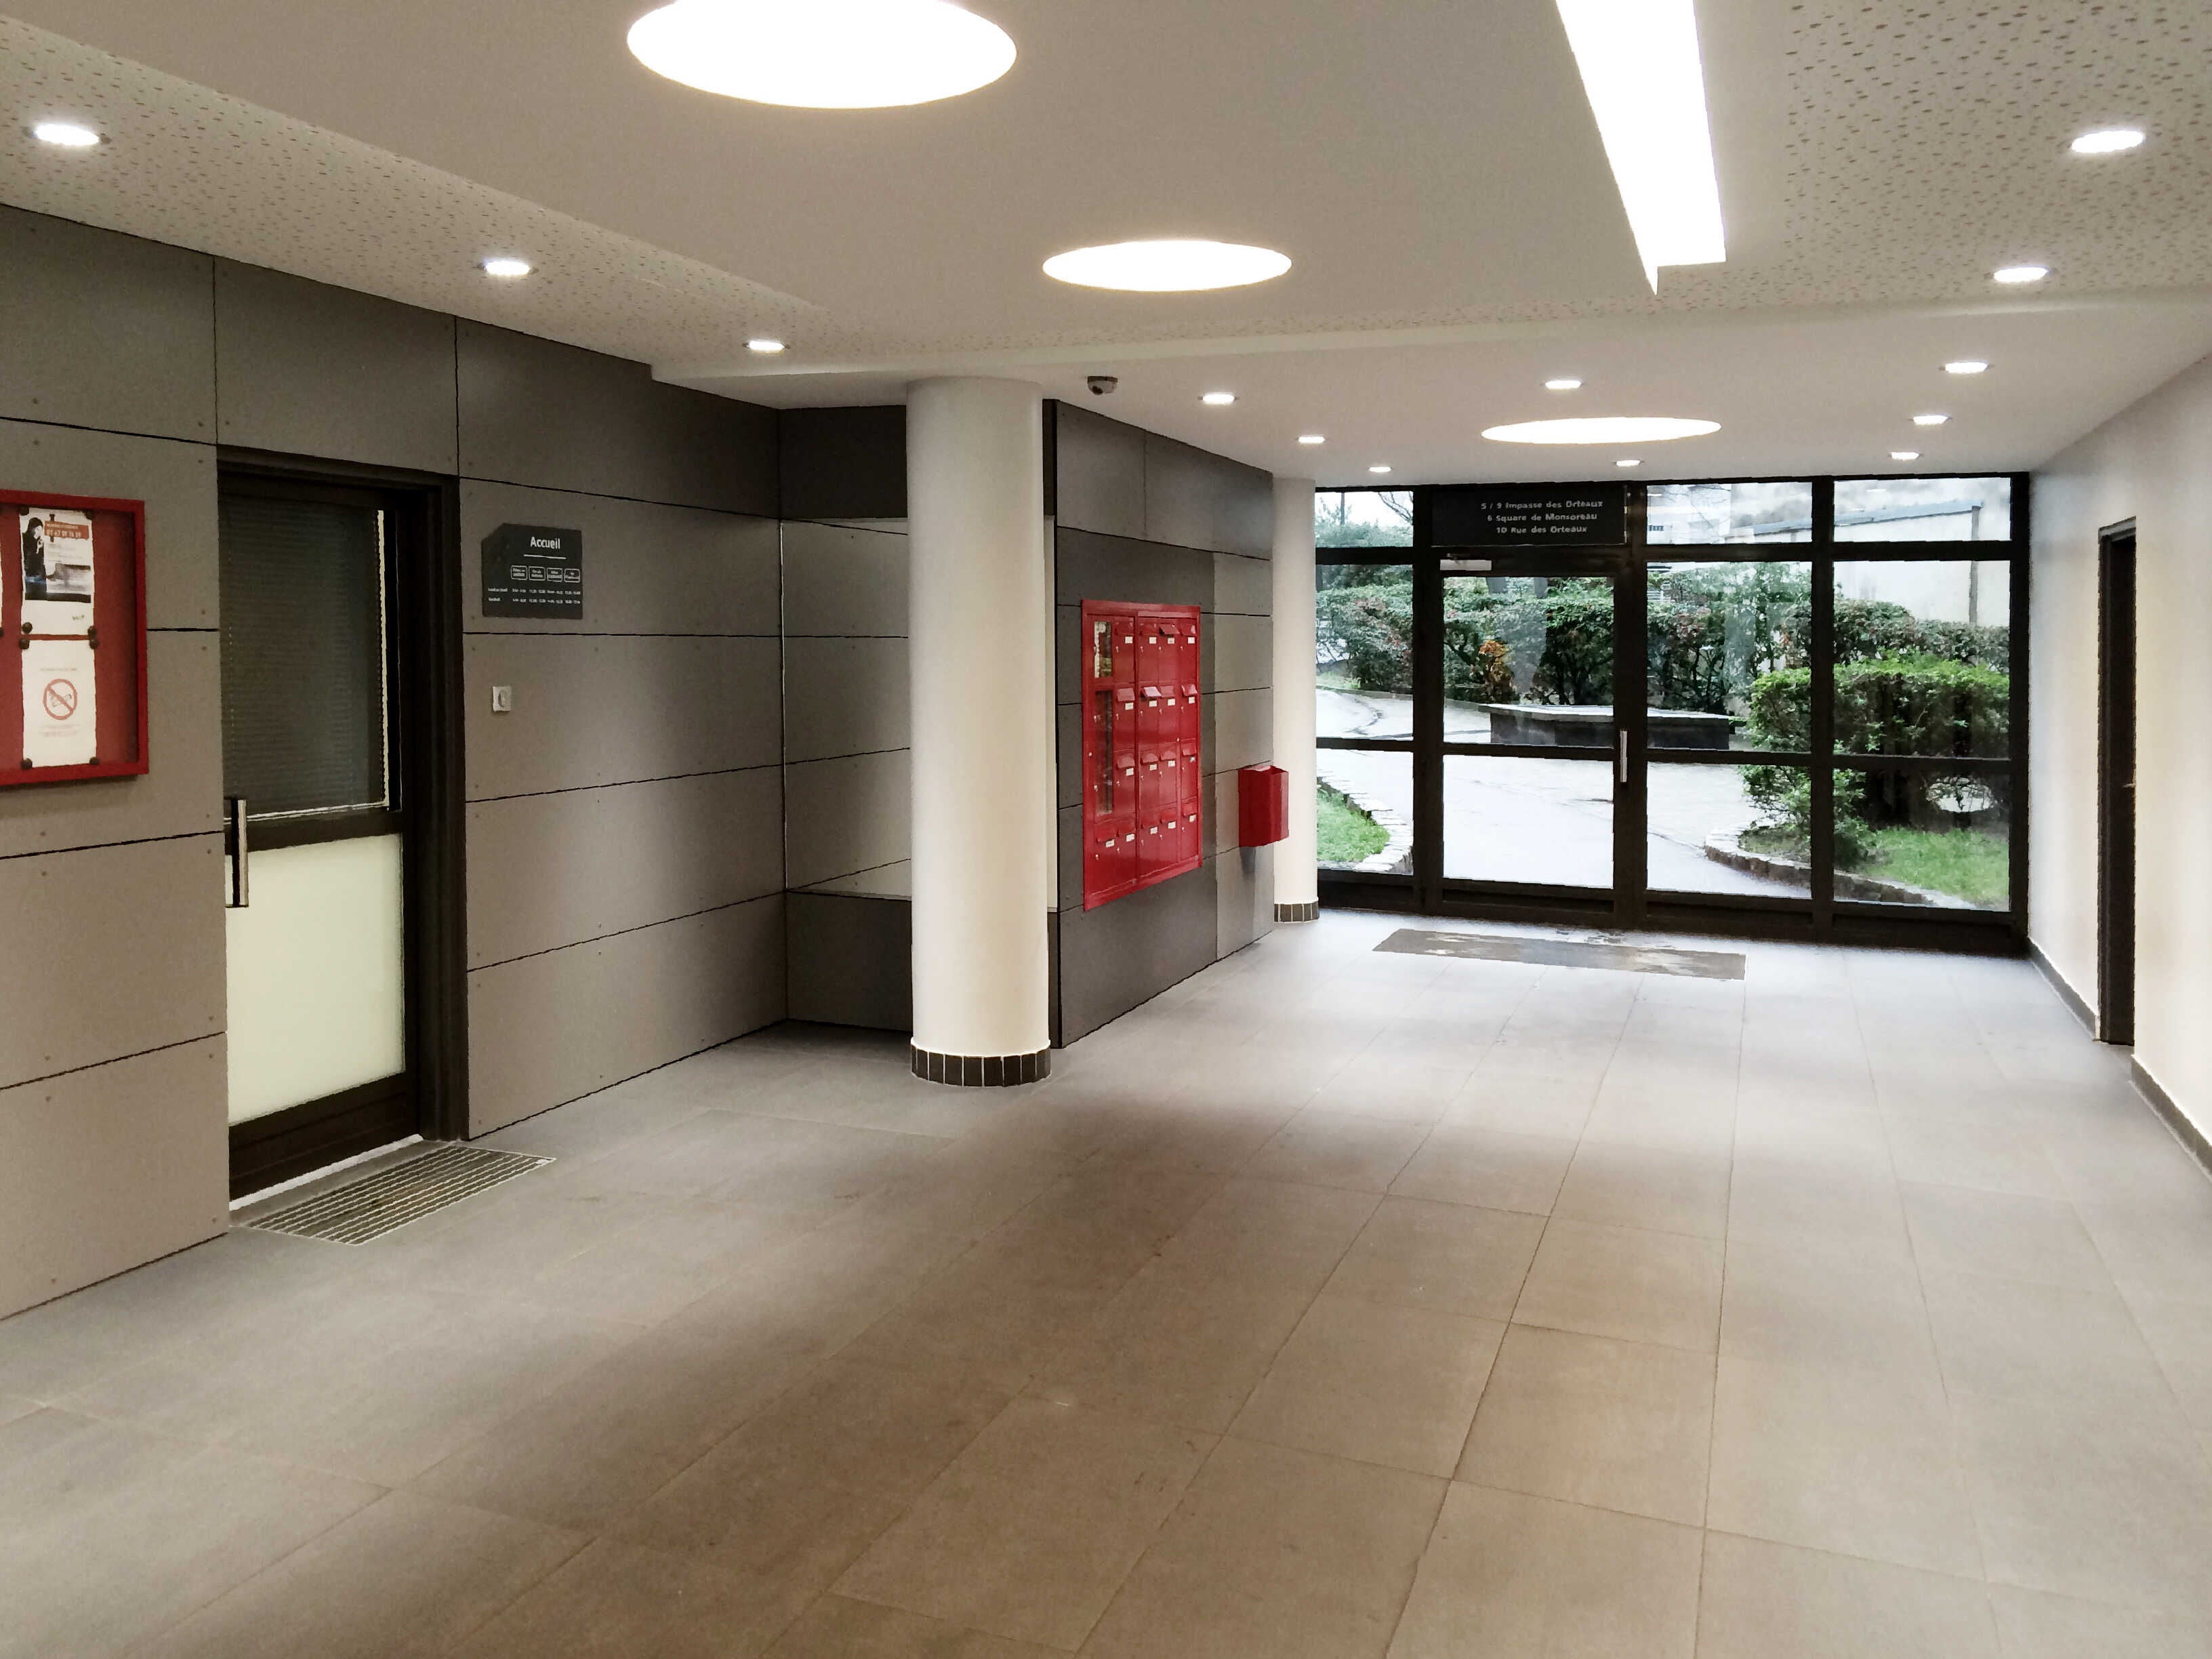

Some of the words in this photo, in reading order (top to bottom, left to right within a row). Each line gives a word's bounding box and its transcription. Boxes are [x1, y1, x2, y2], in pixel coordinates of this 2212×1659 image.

[1505, 501, 1542, 510] Impasse
[1496, 515, 1528, 523] Square
[1530, 525, 1547, 533] des
[530, 535, 561, 550] Accueil
